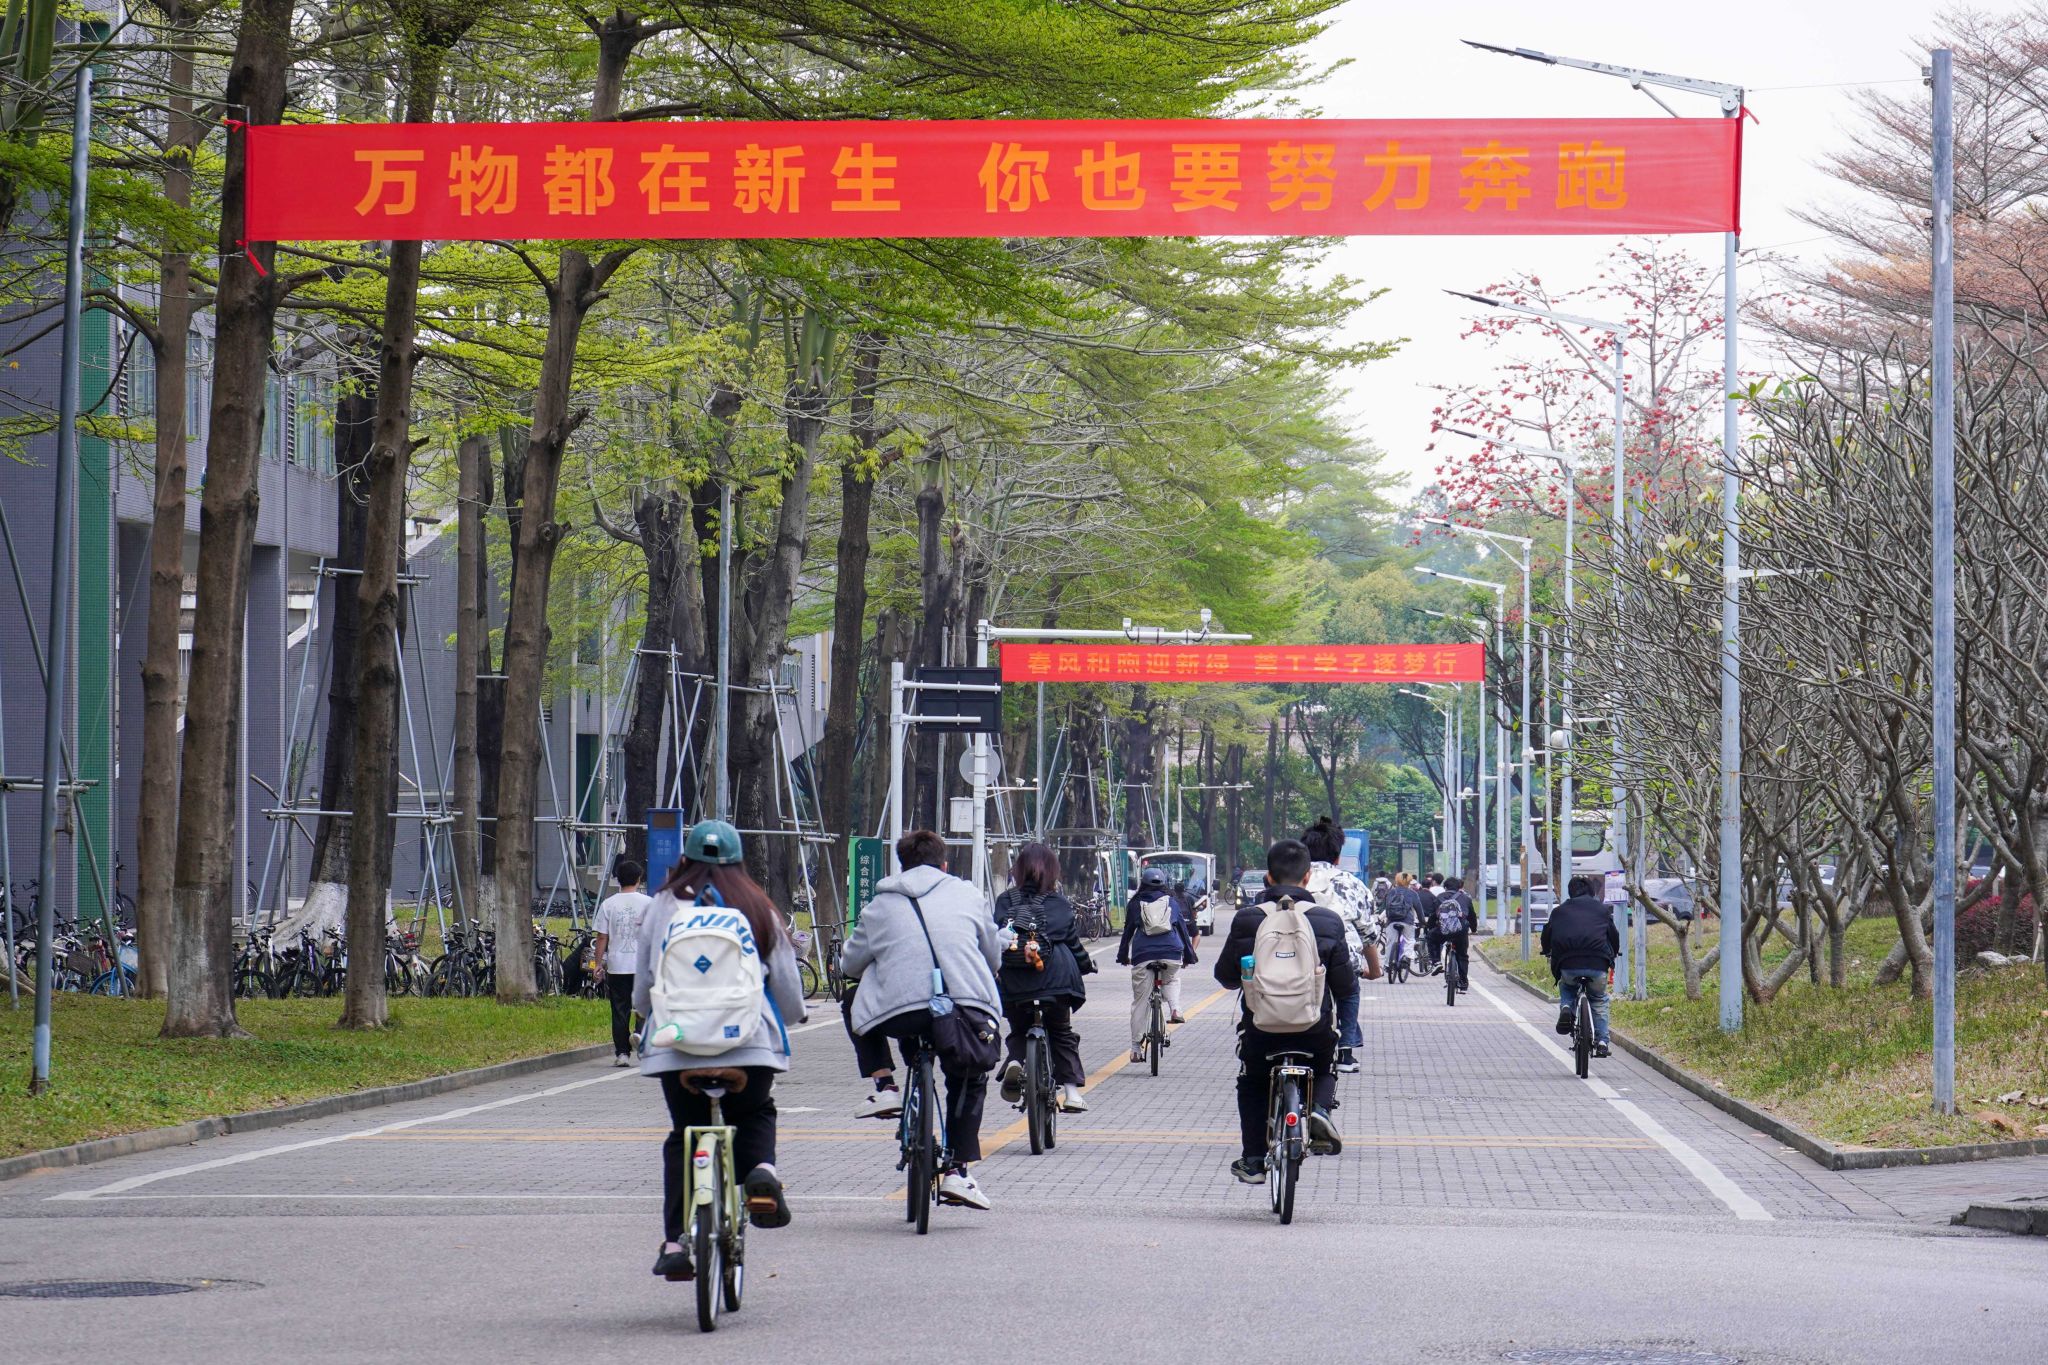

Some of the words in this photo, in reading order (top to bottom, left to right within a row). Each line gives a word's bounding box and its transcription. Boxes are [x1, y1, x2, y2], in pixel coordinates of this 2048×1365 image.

[353, 142, 901, 217] 万物都在新生
[977, 140, 1629, 214] 你也要努力奔跑
[1027, 651, 1230, 675] 春风和煦迎新绿
[1254, 651, 1457, 675] 莞工学子逐梦行
